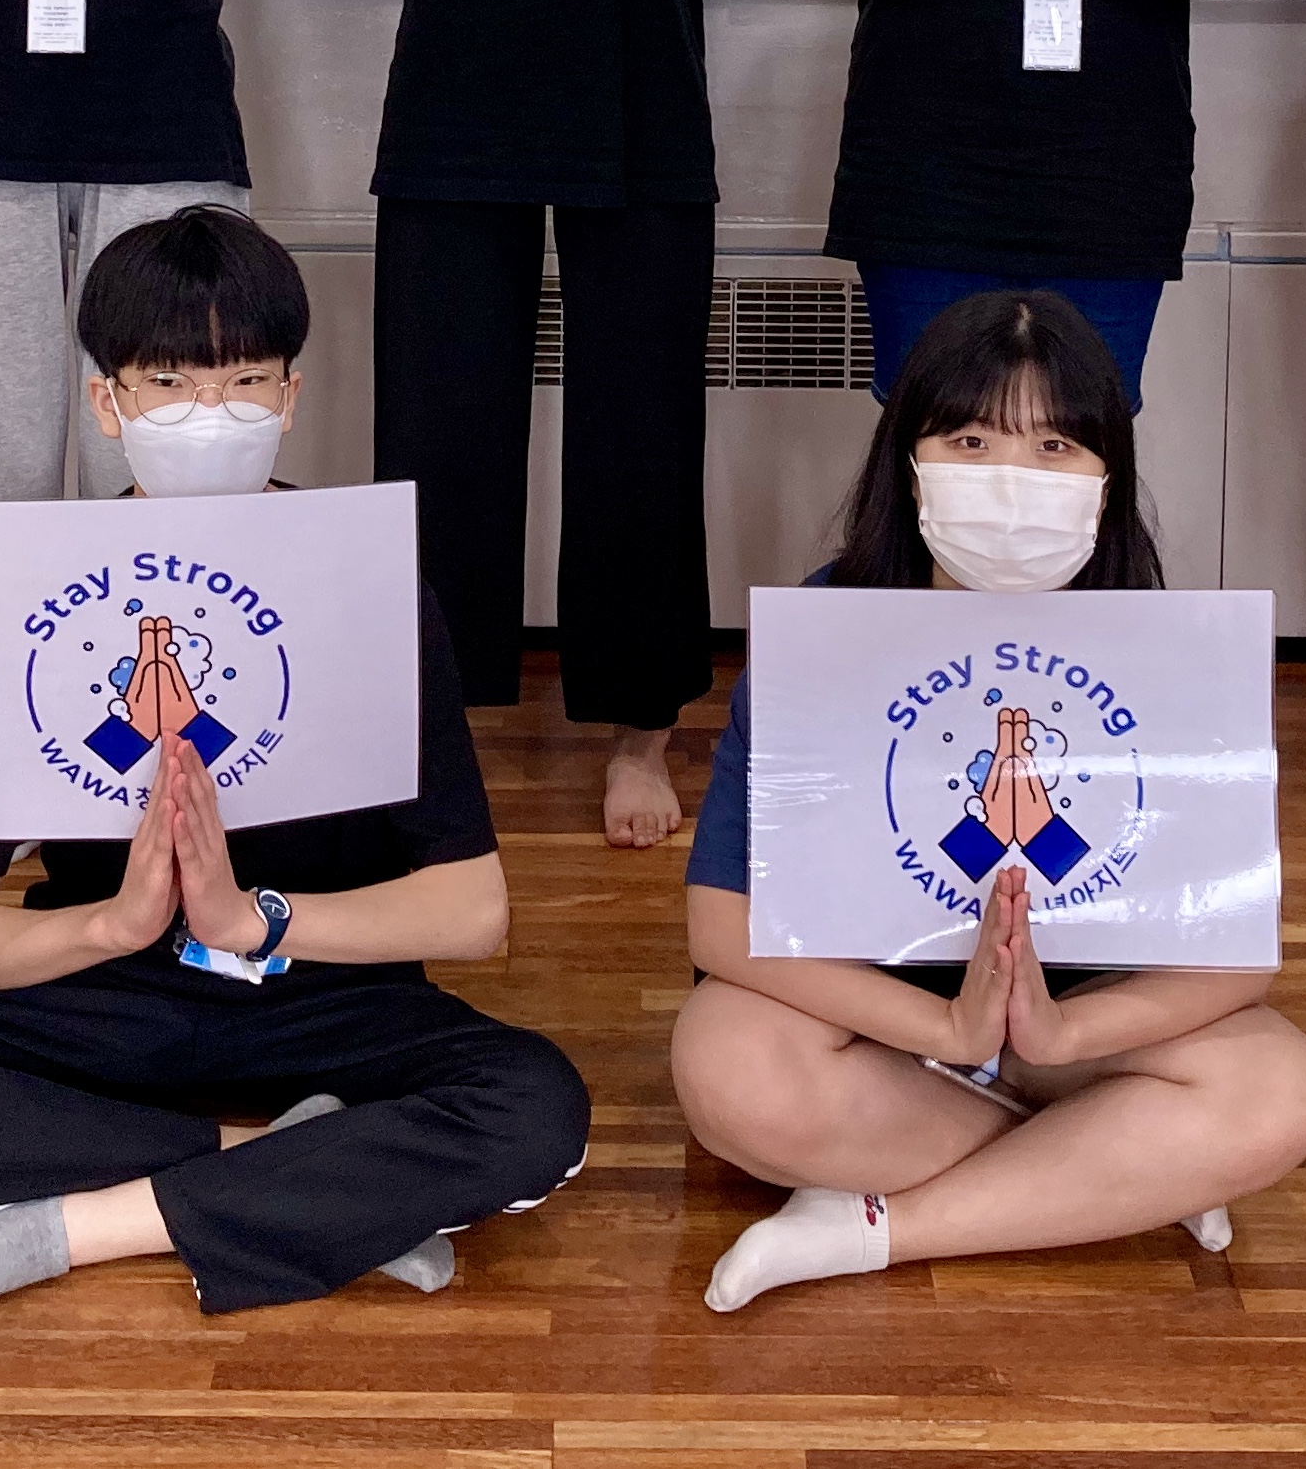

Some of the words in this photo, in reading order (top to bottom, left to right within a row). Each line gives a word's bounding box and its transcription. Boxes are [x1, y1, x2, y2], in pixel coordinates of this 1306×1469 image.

[24, 565, 111, 643] Stay
[133, 552, 284, 638] Strong
[886, 653, 974, 731] Stay
[995, 642, 1138, 739] Strong
